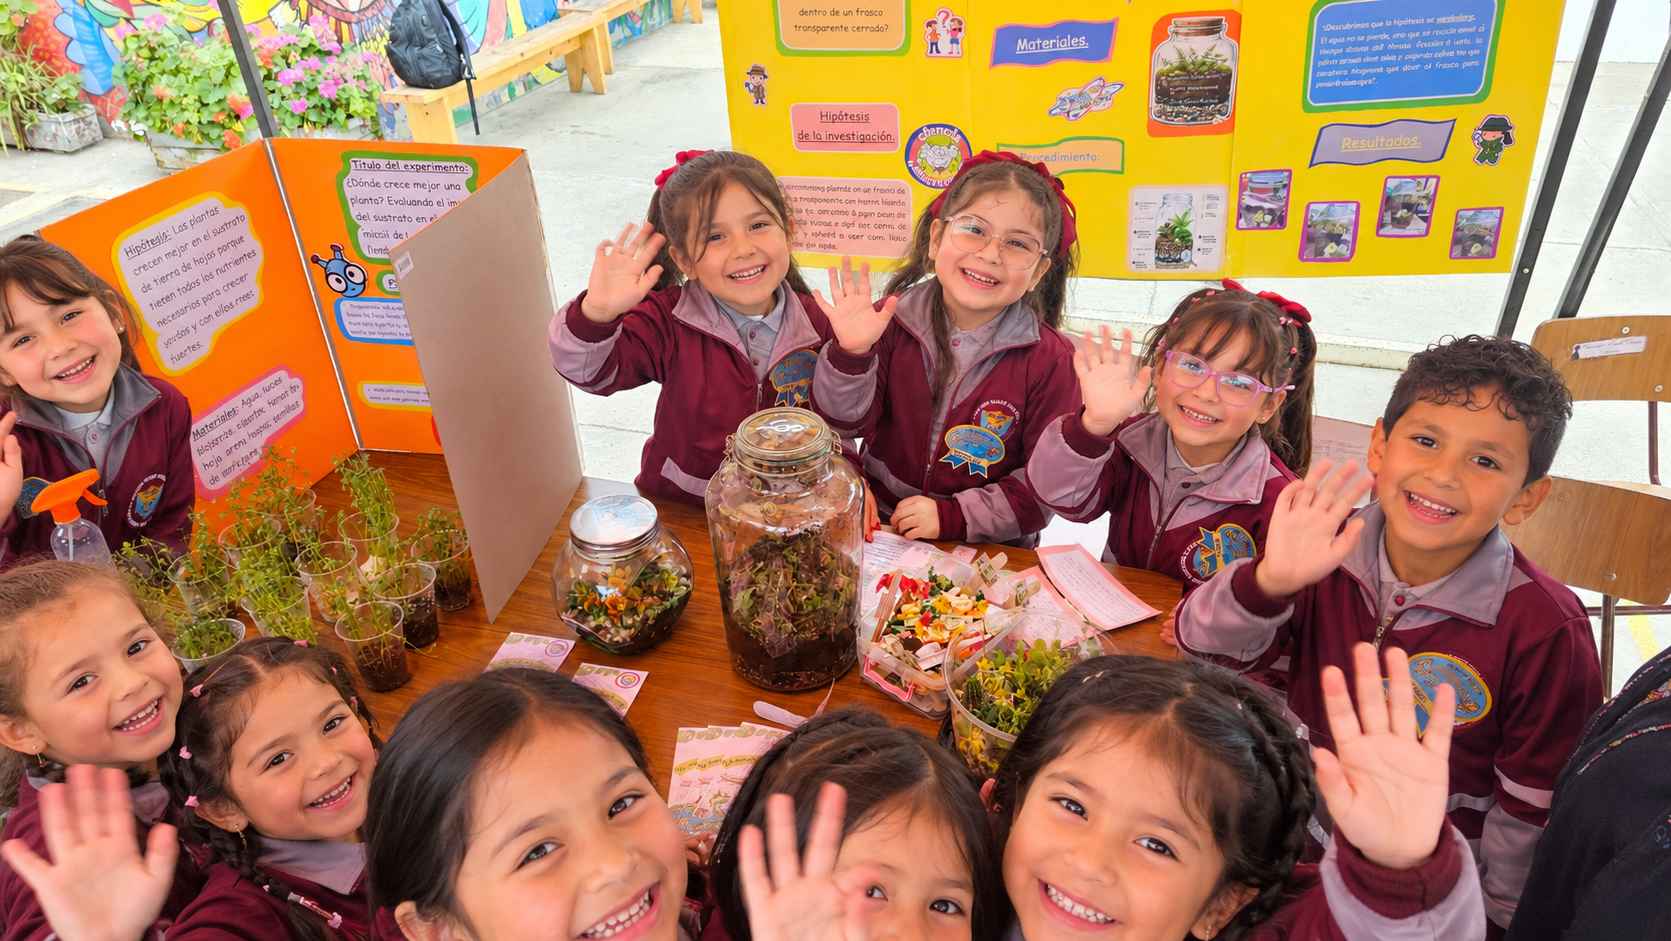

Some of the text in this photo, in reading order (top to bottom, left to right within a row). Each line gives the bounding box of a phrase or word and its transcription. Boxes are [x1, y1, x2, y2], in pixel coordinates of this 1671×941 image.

[799, 8, 884, 17] dentro de un frasco
[794, 24, 889, 34] transparente cerrado?
[1016, 34, 1089, 53] Materiales.
[819, 110, 871, 122] Hipótesis
[798, 130, 895, 143] de la investigación.
[1342, 134, 1422, 150] Resultados.
[352, 160, 469, 174] Título del experimento:
[346, 178, 461, 193] ¿Dónde crece mejor una
[349, 196, 385, 208] planta?
[387, 197, 434, 207] Evaluando
[436, 199, 445, 208] el
[355, 213, 370, 221] del
[373, 214, 413, 223] sustrato
[133, 214, 246, 277] crecen mejor en el sustrato
[140, 282, 153, 294] de
[182, 262, 193, 274] de
[202, 289, 221, 307] para
[222, 273, 249, 293] crecer
[199, 313, 214, 327] con
